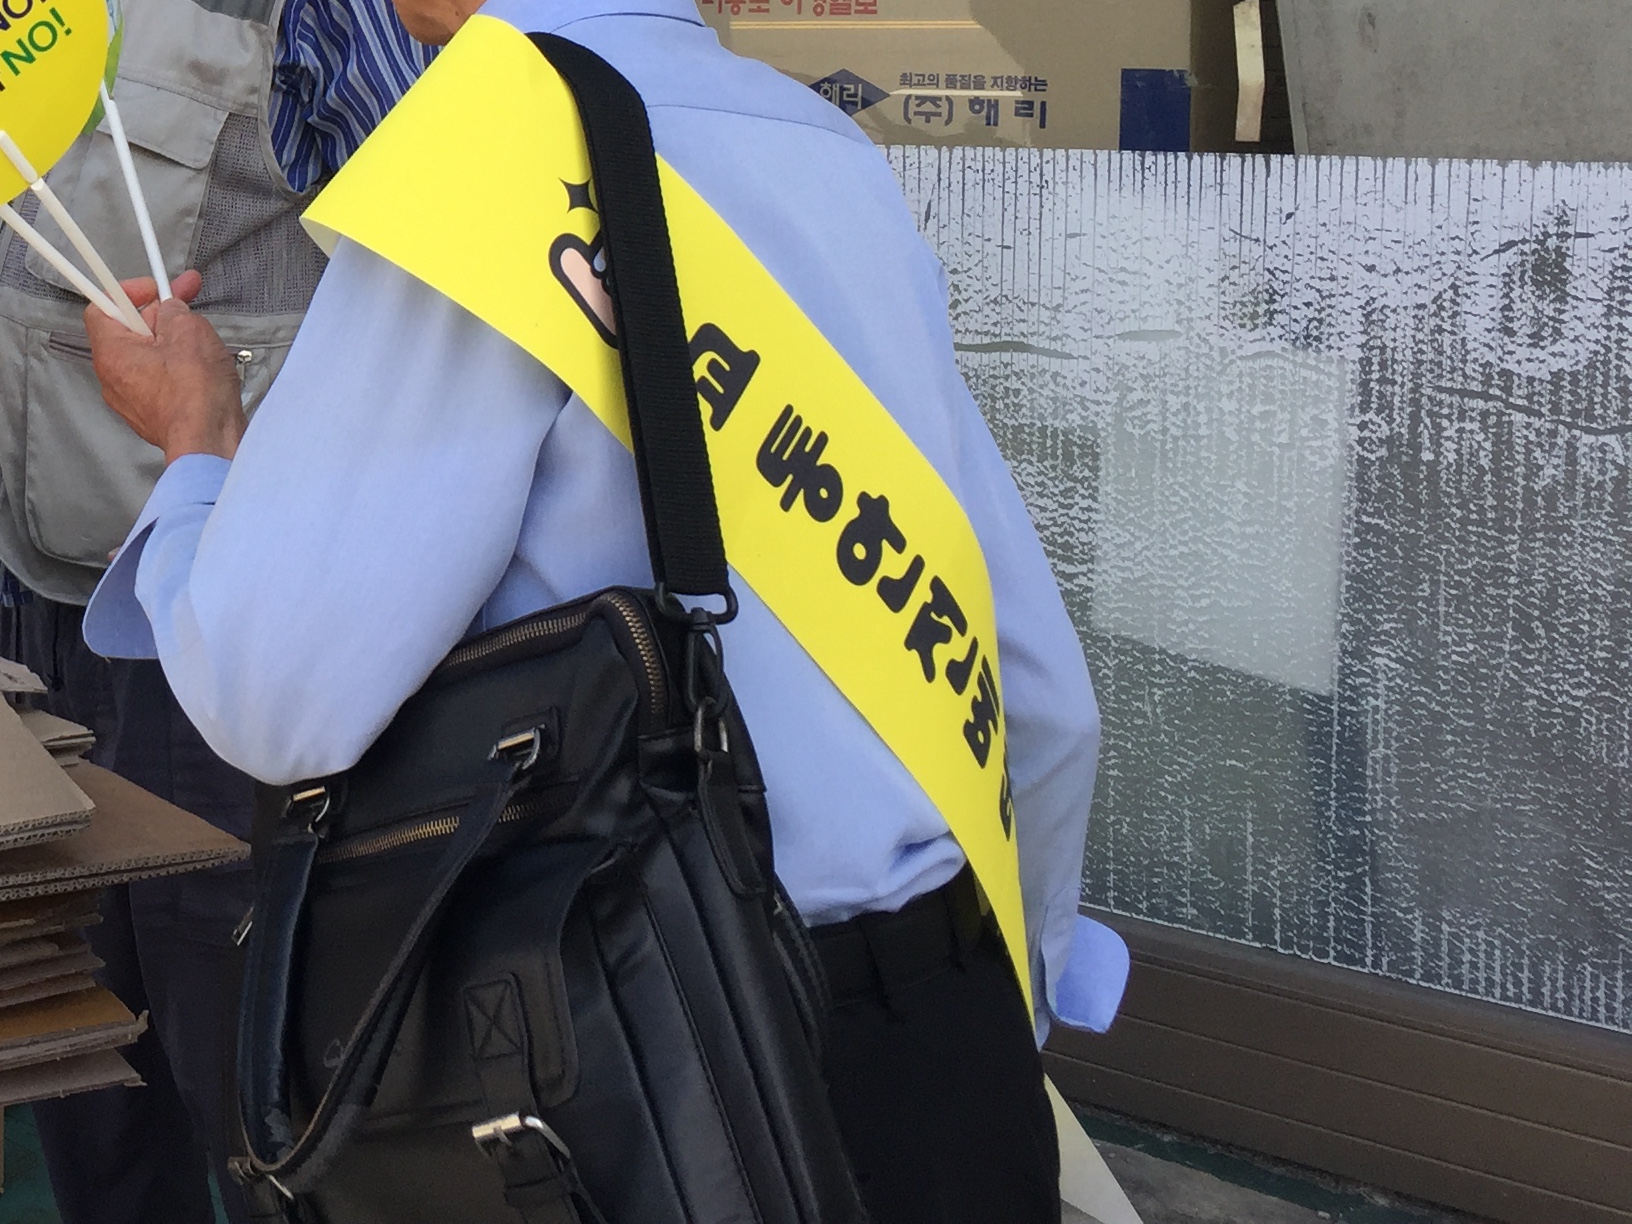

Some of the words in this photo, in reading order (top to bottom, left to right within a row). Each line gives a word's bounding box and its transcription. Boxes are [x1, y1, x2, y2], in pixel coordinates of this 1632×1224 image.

[0, 7, 72, 76] NO!
[899, 73, 939, 88] 최고의
[944, 74, 986, 90] 품질을
[990, 75, 1048, 92] 지향하는
[820, 83, 862, 109] 해리
